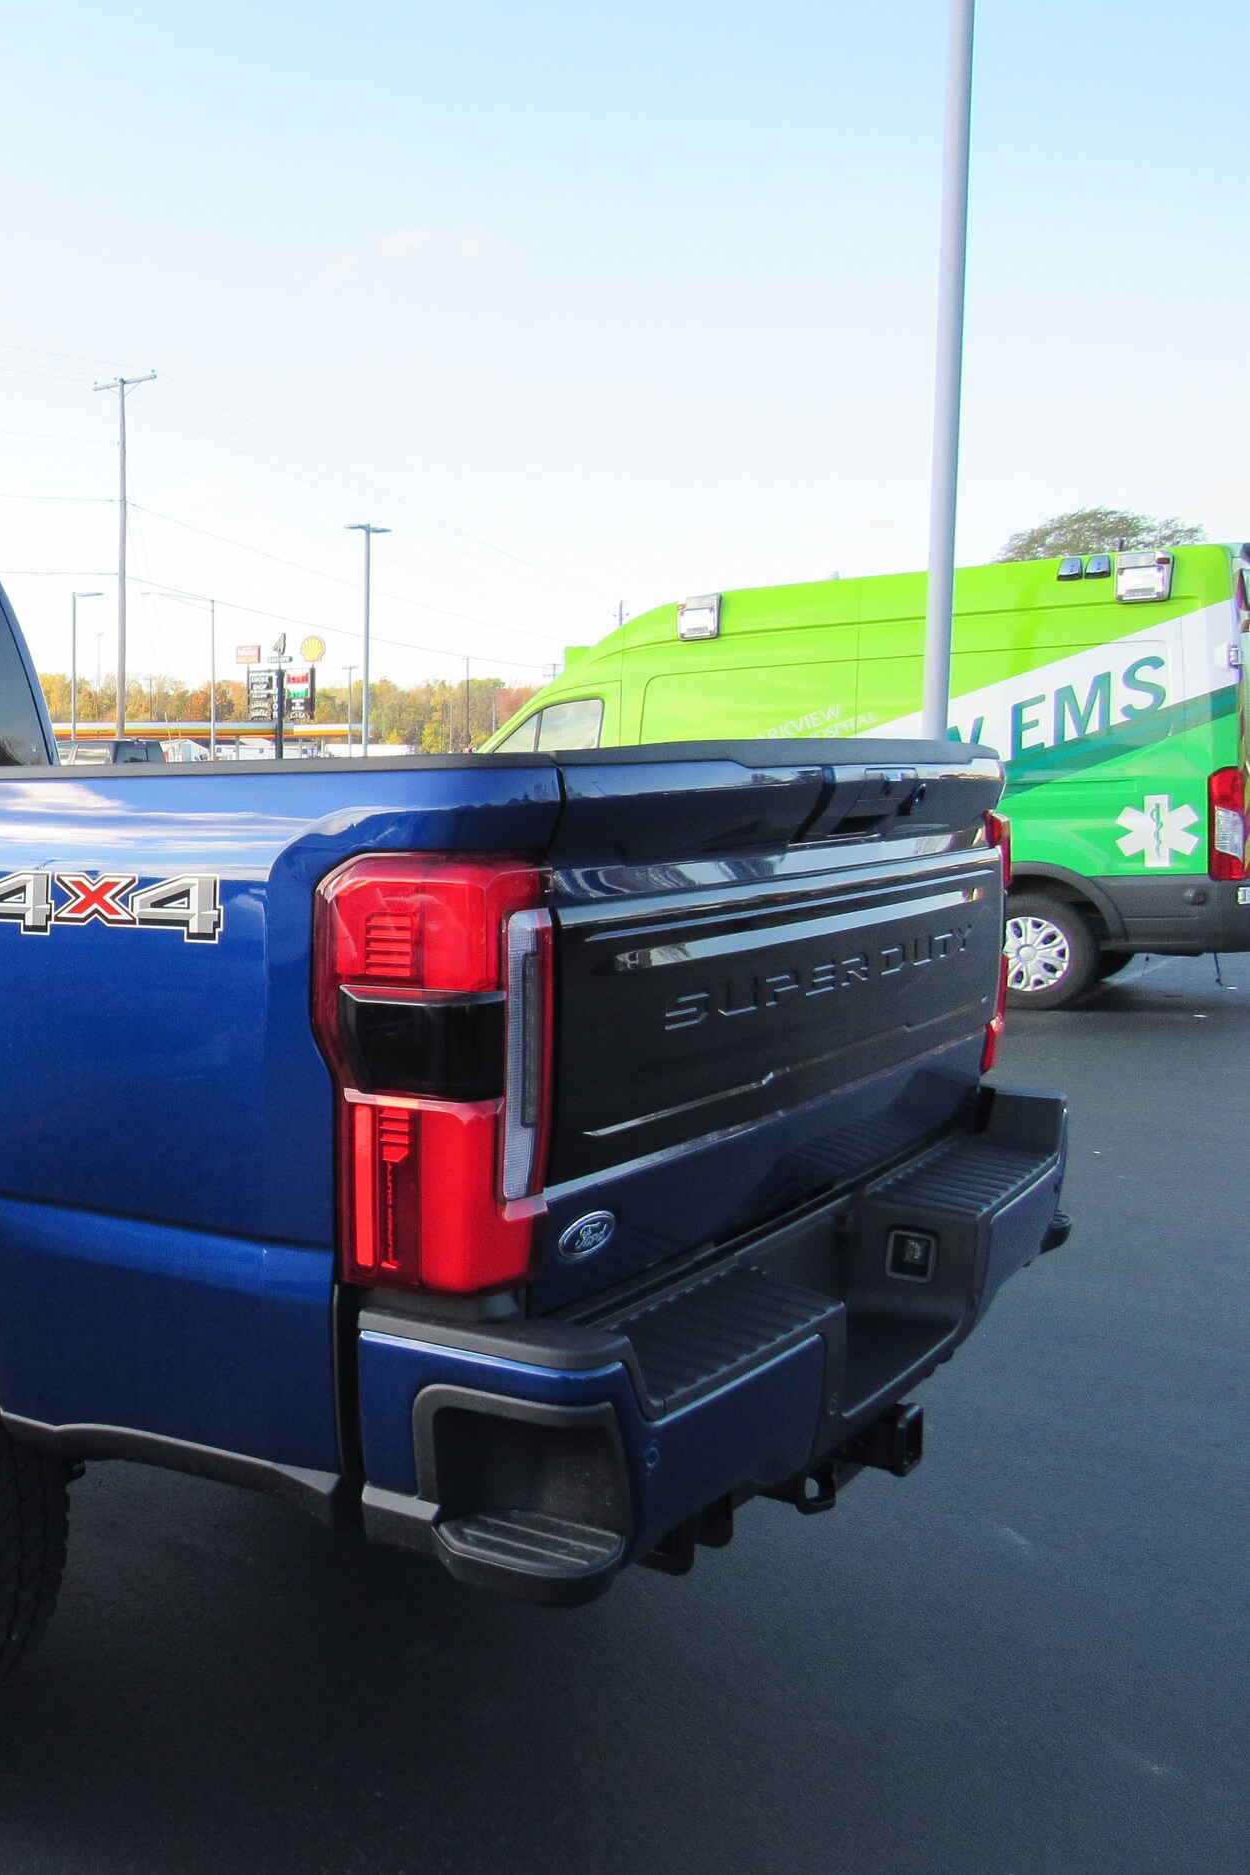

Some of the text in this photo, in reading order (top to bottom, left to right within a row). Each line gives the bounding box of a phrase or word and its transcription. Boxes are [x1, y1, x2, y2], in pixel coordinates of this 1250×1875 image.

[748, 704, 843, 739] ARKVIEW
[1011, 656, 1166, 760] EMS
[664, 924, 972, 1030] SUPER DUTY
[575, 1221, 608, 1249] Ford
